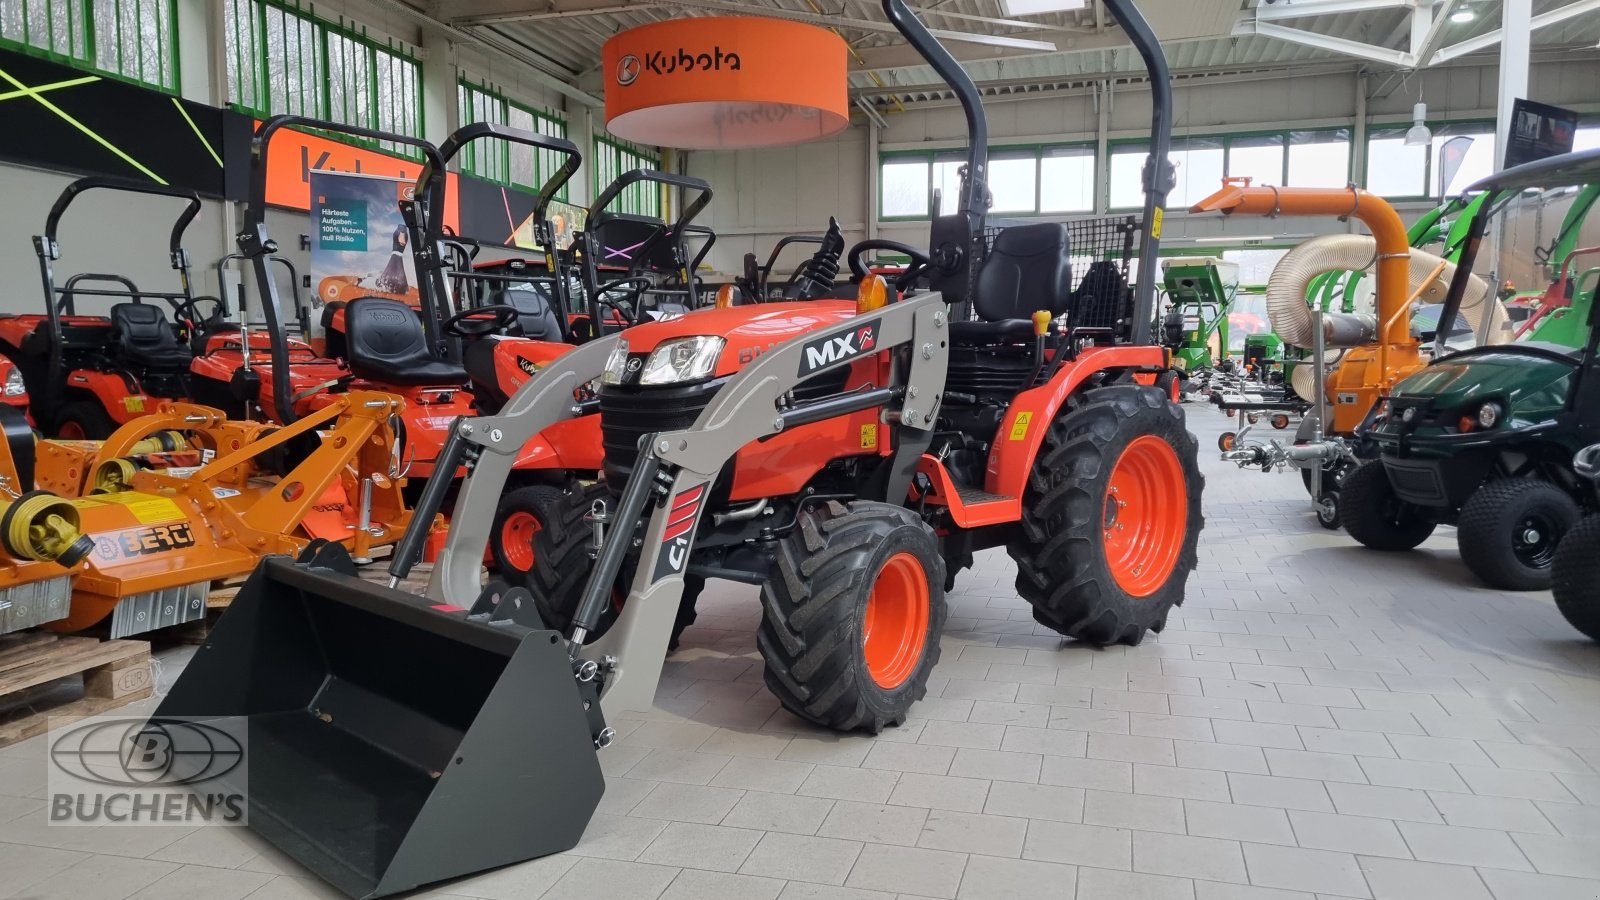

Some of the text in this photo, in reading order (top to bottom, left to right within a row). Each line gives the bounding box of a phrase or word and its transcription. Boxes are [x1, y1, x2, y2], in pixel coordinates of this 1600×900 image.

[645, 46, 741, 75] Kubota
[321, 208, 349, 217] Härteste
[322, 217, 352, 226] Aufgaben
[322, 226, 366, 236] 100% Nutzen,
[322, 234, 355, 243] null Risiko
[805, 331, 858, 370] MX
